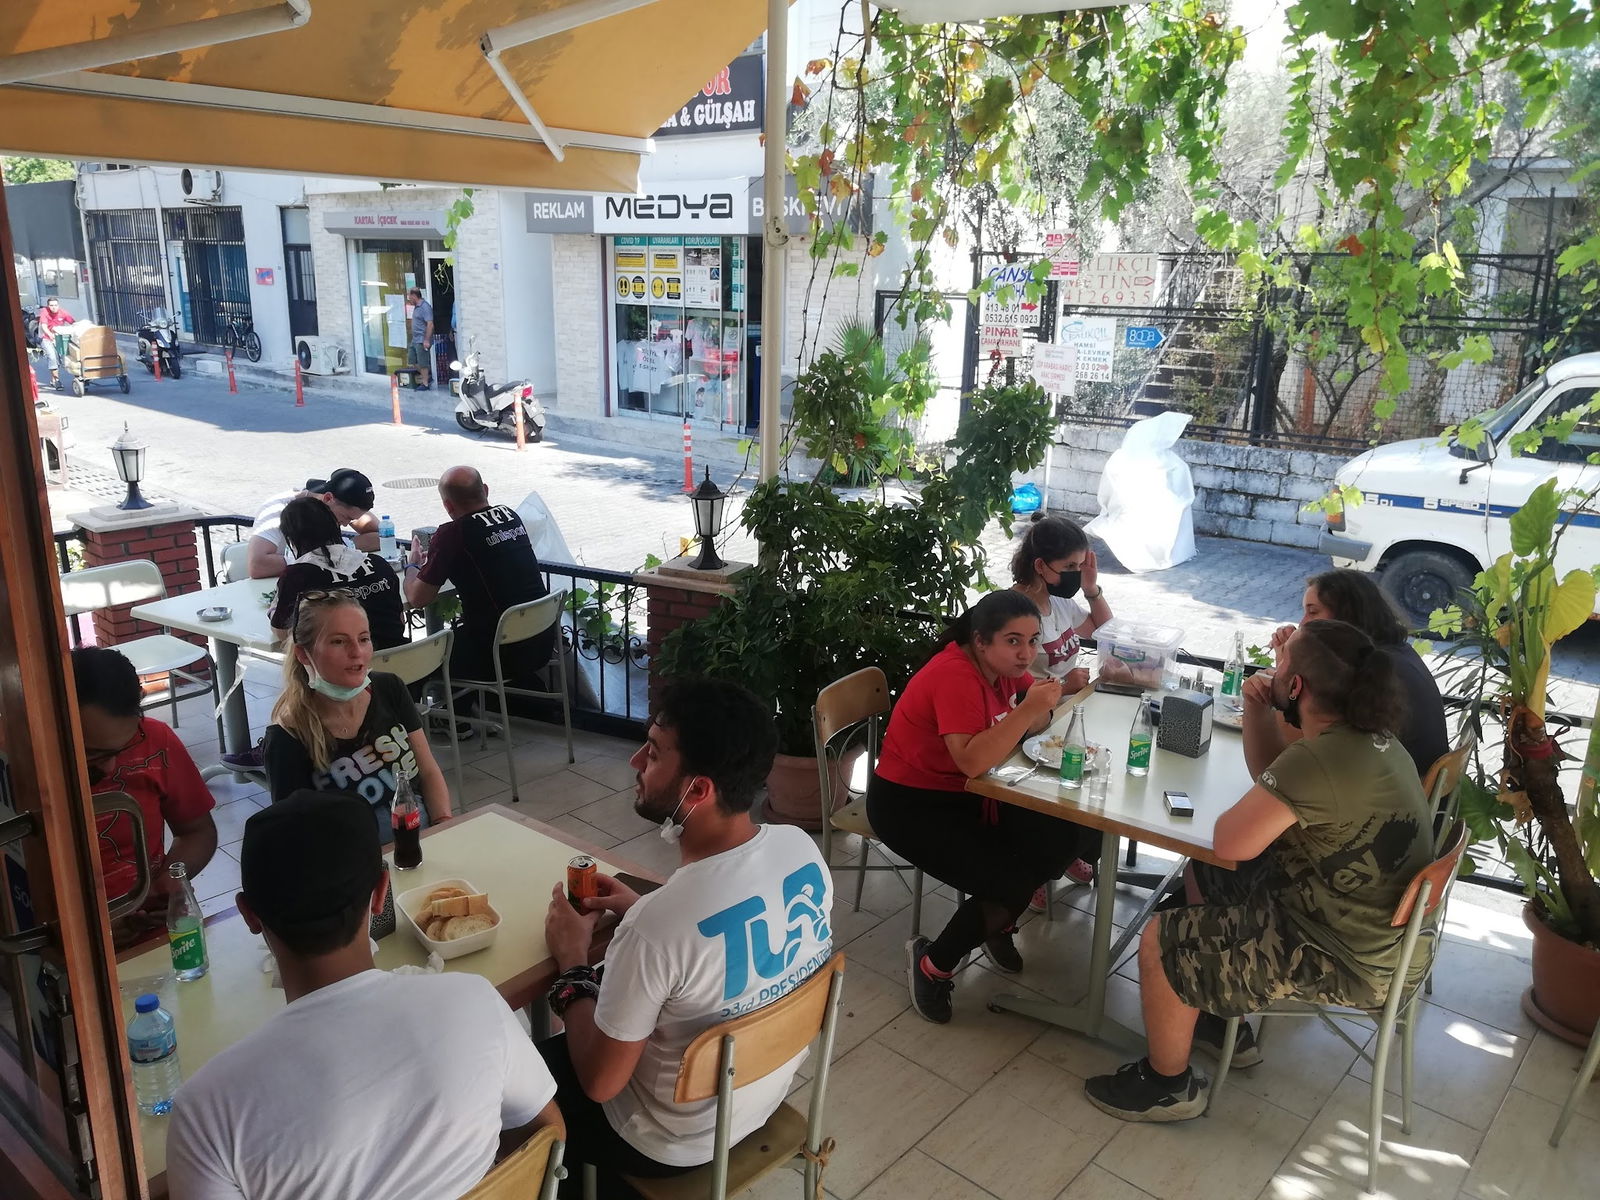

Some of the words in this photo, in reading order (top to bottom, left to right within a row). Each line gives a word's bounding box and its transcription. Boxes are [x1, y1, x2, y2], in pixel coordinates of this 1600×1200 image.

[680, 107, 691, 127] &
[694, 99, 755, 128] GÜLŞAH
[533, 201, 585, 219] REKLAM
[752, 196, 806, 217] BSKI
[985, 303, 999, 312] 413
[1019, 314, 1038, 324] 0923
[472, 505, 515, 527] TFF
[1130, 747, 1150, 762] Sprite
[357, 750, 420, 805] OVE
